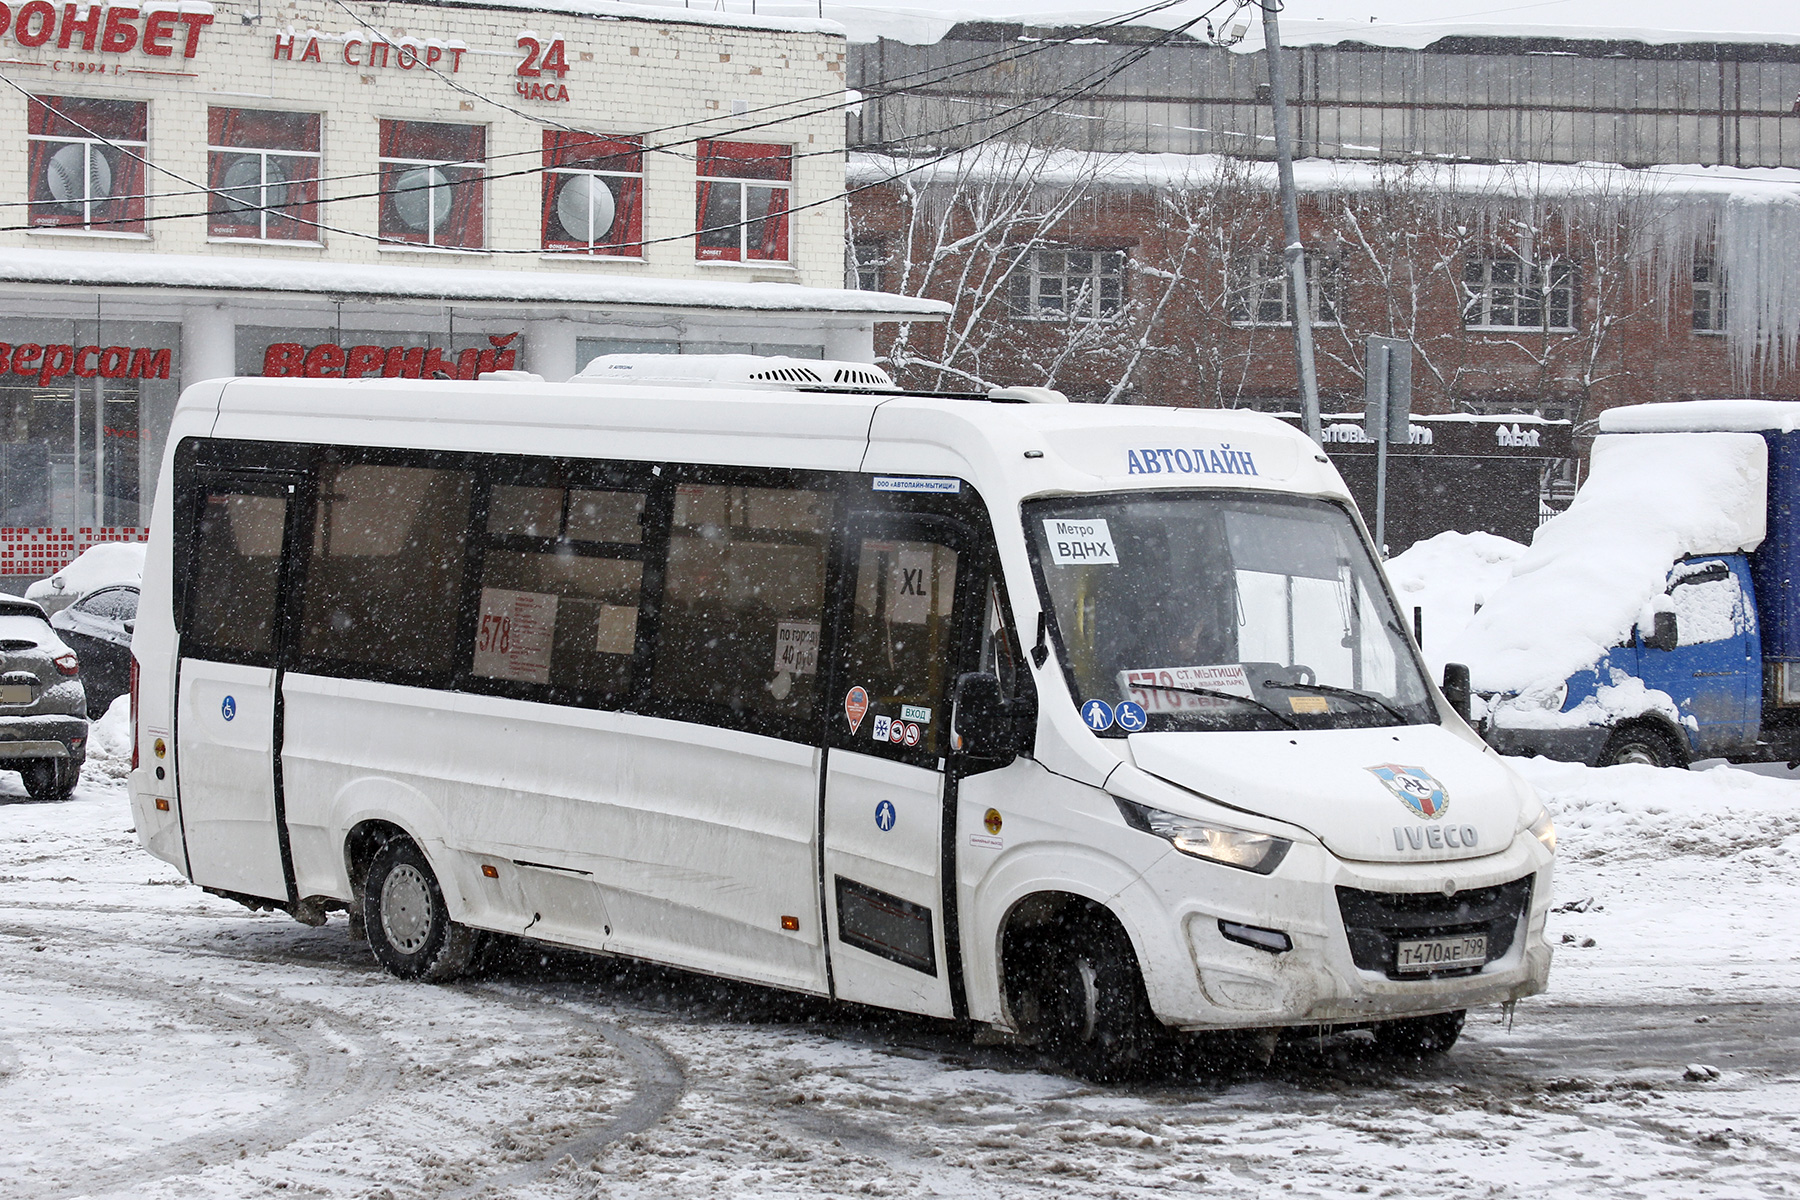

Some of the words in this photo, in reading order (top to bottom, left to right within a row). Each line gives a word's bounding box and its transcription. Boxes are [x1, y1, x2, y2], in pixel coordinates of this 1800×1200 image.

[0, 0, 214, 59] ОНБЕТ
[273, 34, 322, 63] НА
[344, 39, 467, 73] СПОРТ
[516, 36, 570, 78] 24
[53, 60, 61, 72] С
[70, 61, 106, 74] 1994
[516, 81, 570, 102] ЧАСА
[1497, 430, 1541, 447] ТАБАК
[1127, 443, 1259, 476] АВТОЛАЙН
[876, 480, 889, 488] ООО
[1056, 522, 1095, 537] Метро
[1057, 541, 1111, 560] ВДНХ
[900, 568, 927, 596] XL
[479, 613, 511, 655] 578
[782, 645, 795, 665] 40
[1176, 670, 1193, 680] СТ.
[1194, 667, 1244, 680] МЫТИЩИ
[1128, 671, 1182, 711] 578
[905, 708, 926, 720] ВХОД
[1393, 823, 1479, 852] IVECO
[1464, 938, 1484, 955] 799
